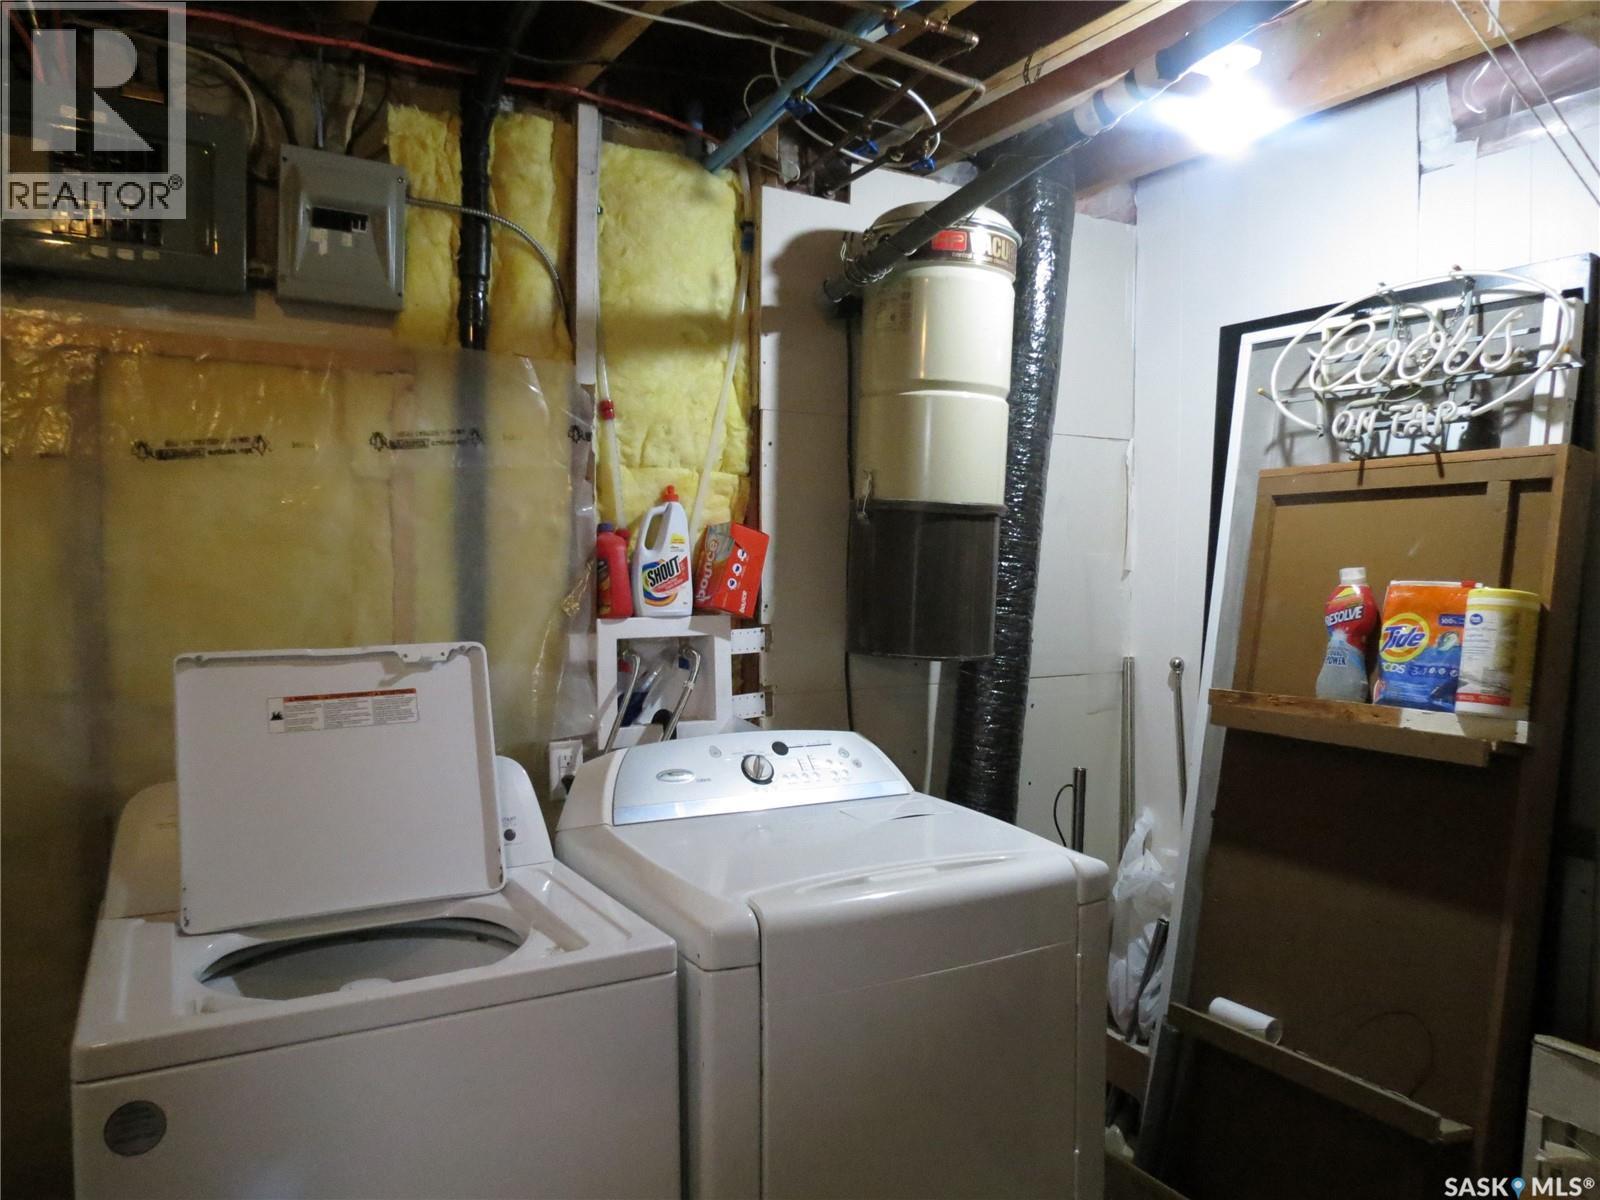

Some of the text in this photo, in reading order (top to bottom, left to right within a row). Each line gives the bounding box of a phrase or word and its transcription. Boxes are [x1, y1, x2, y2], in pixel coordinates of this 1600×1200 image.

[1332, 401, 1459, 440] ON TAP
[647, 555, 680, 588] SHOUT
[695, 538, 719, 602] bounce
[1324, 605, 1364, 627] RESOLVE
[1380, 624, 1426, 652] Tide
